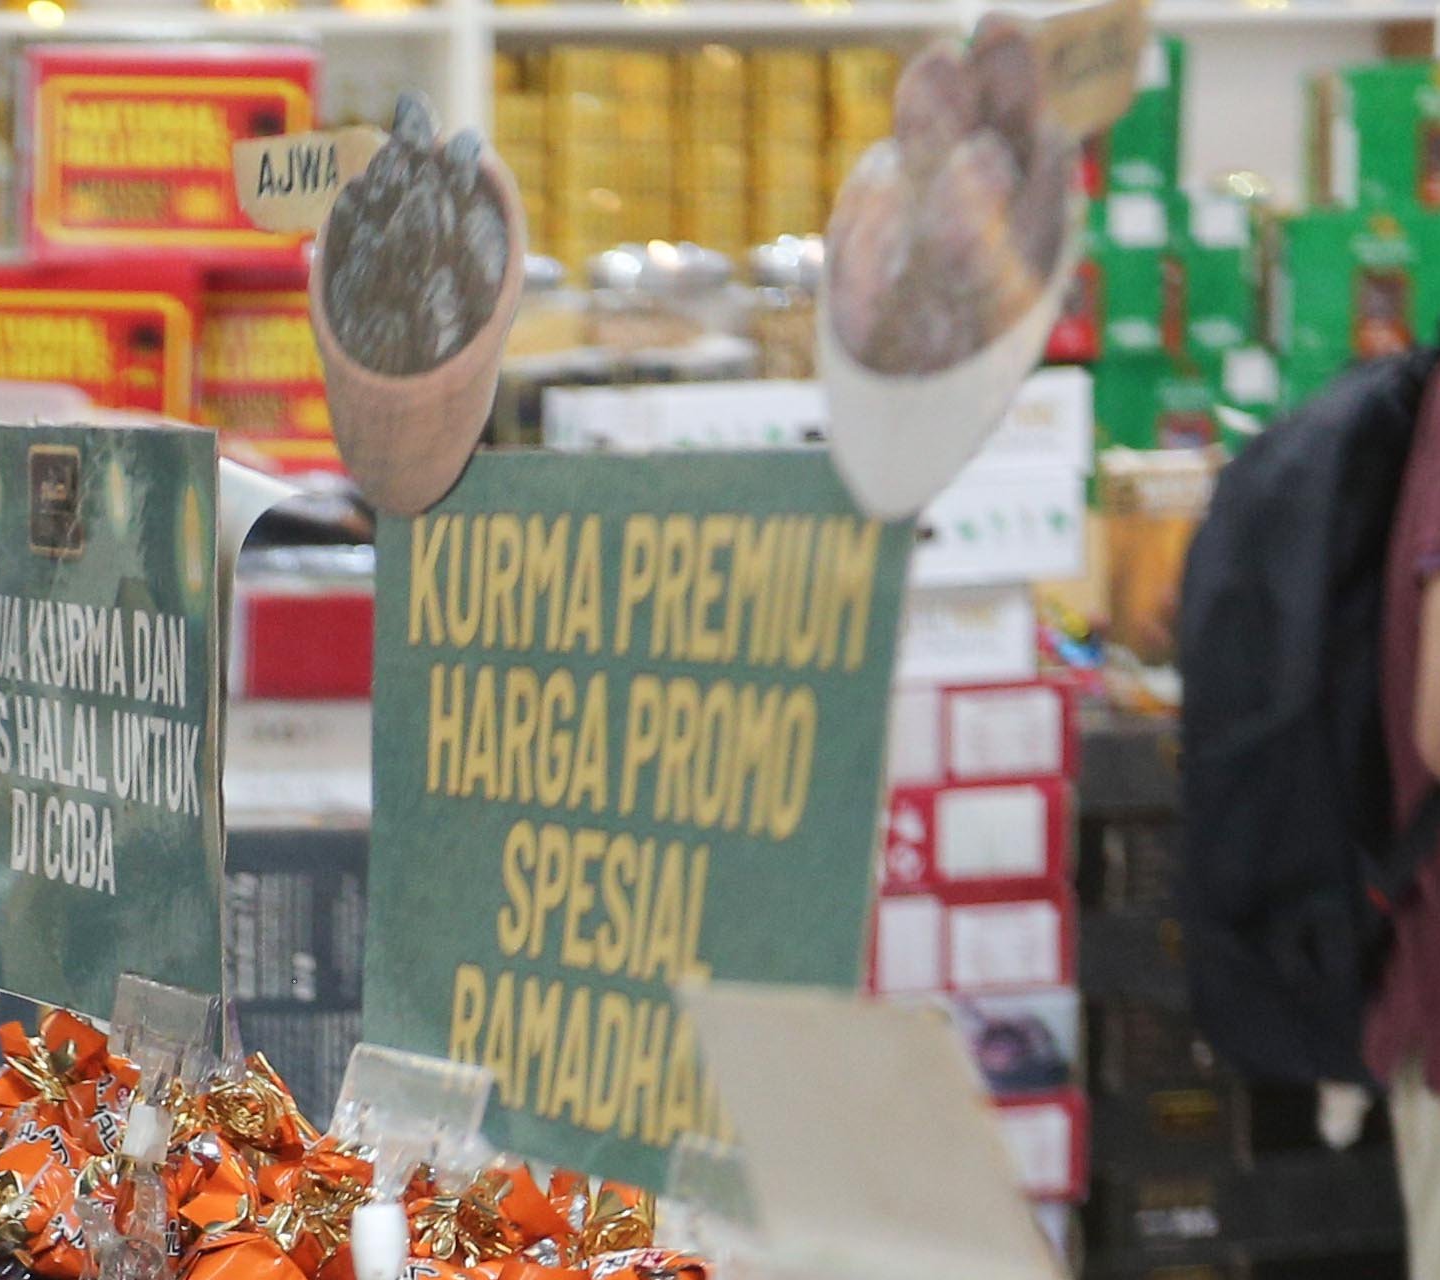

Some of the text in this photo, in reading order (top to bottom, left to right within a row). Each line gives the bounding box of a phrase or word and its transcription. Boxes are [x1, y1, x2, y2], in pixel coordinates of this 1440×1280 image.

[257, 144, 340, 198] AJWA
[408, 513, 882, 671] KURMA PREMIUM
[28, 599, 126, 696] KURMA
[133, 609, 186, 709] DAN
[15, 695, 107, 793] HALAL
[112, 710, 200, 817] UNTUK
[427, 662, 817, 841] HARGA PROMO
[10, 788, 116, 895] DI COBA
[497, 819, 712, 987] SPESIAL
